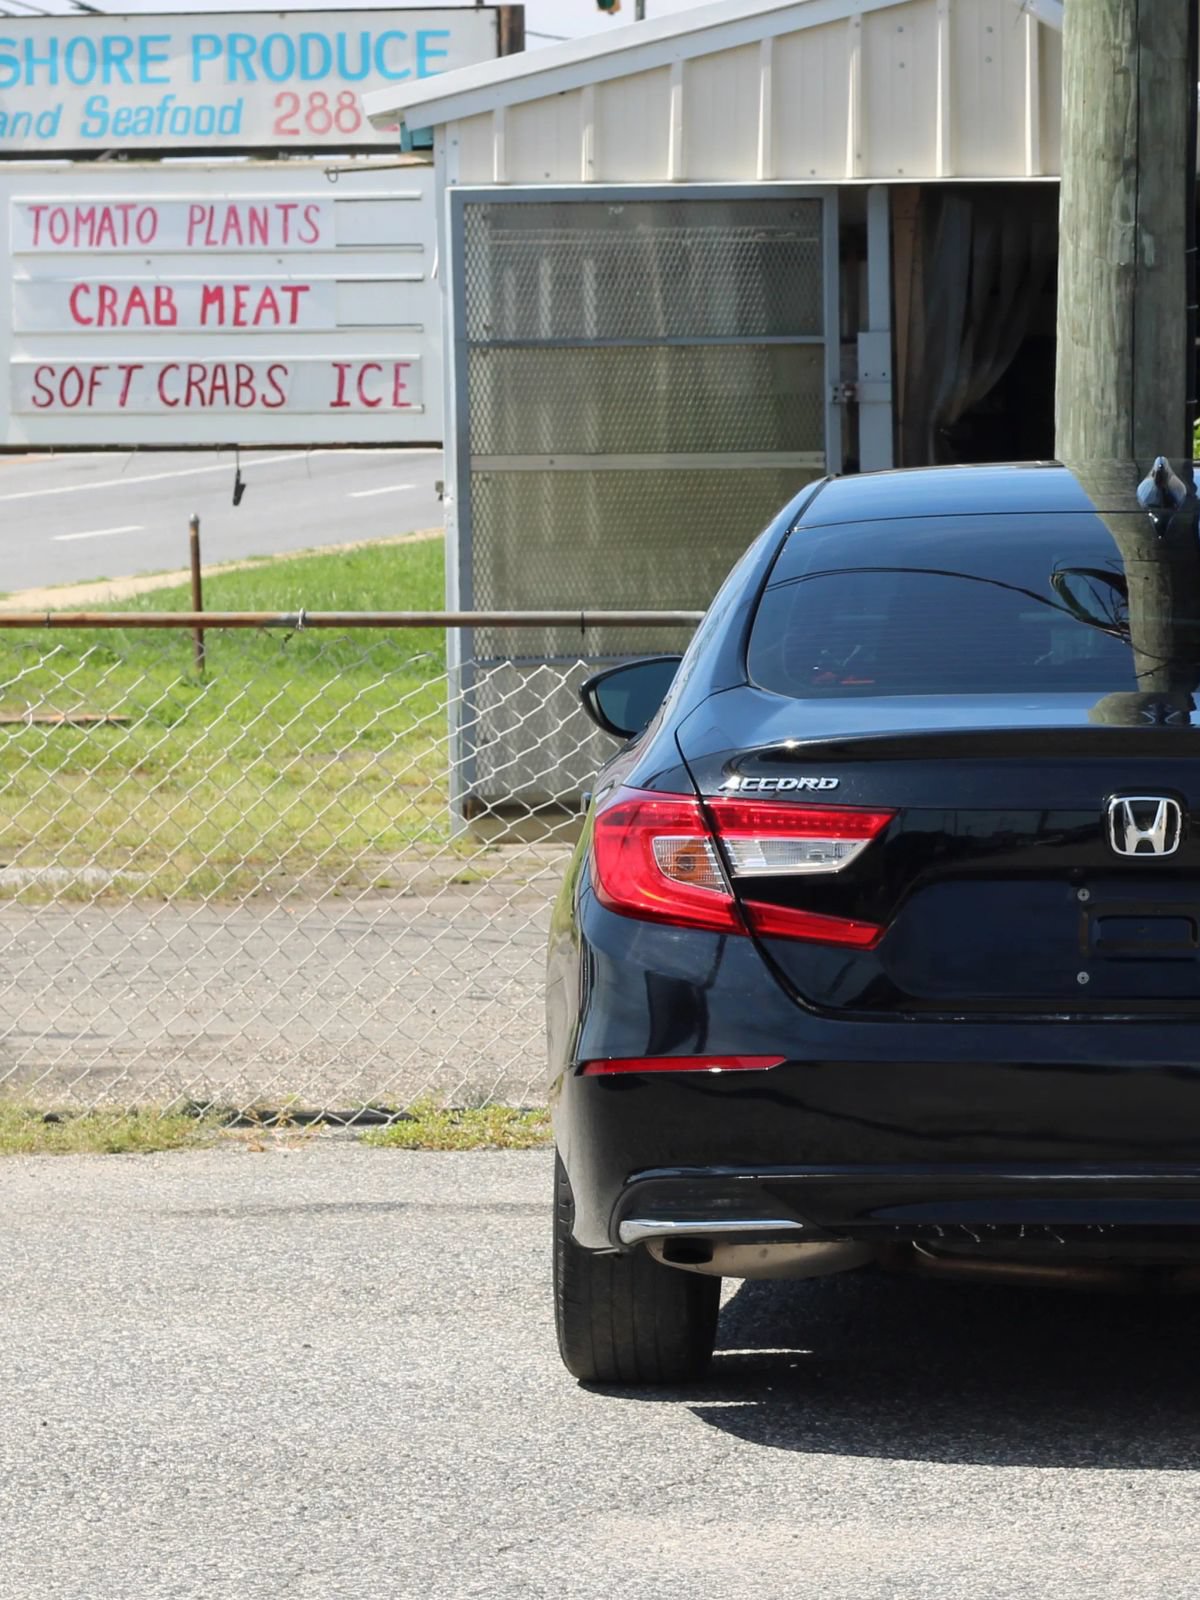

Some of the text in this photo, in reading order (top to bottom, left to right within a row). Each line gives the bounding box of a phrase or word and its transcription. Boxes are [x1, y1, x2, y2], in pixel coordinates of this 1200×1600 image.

[0, 29, 450, 88] SHORE PRODUCE
[80, 94, 244, 138] Seafood
[273, 90, 400, 136] 288
[28, 203, 320, 246] TOMATO PLANTS
[69, 283, 311, 328] CRAB MEAT
[32, 362, 412, 409] SOFT CRABS ICE
[718, 776, 839, 791] ACCORD
